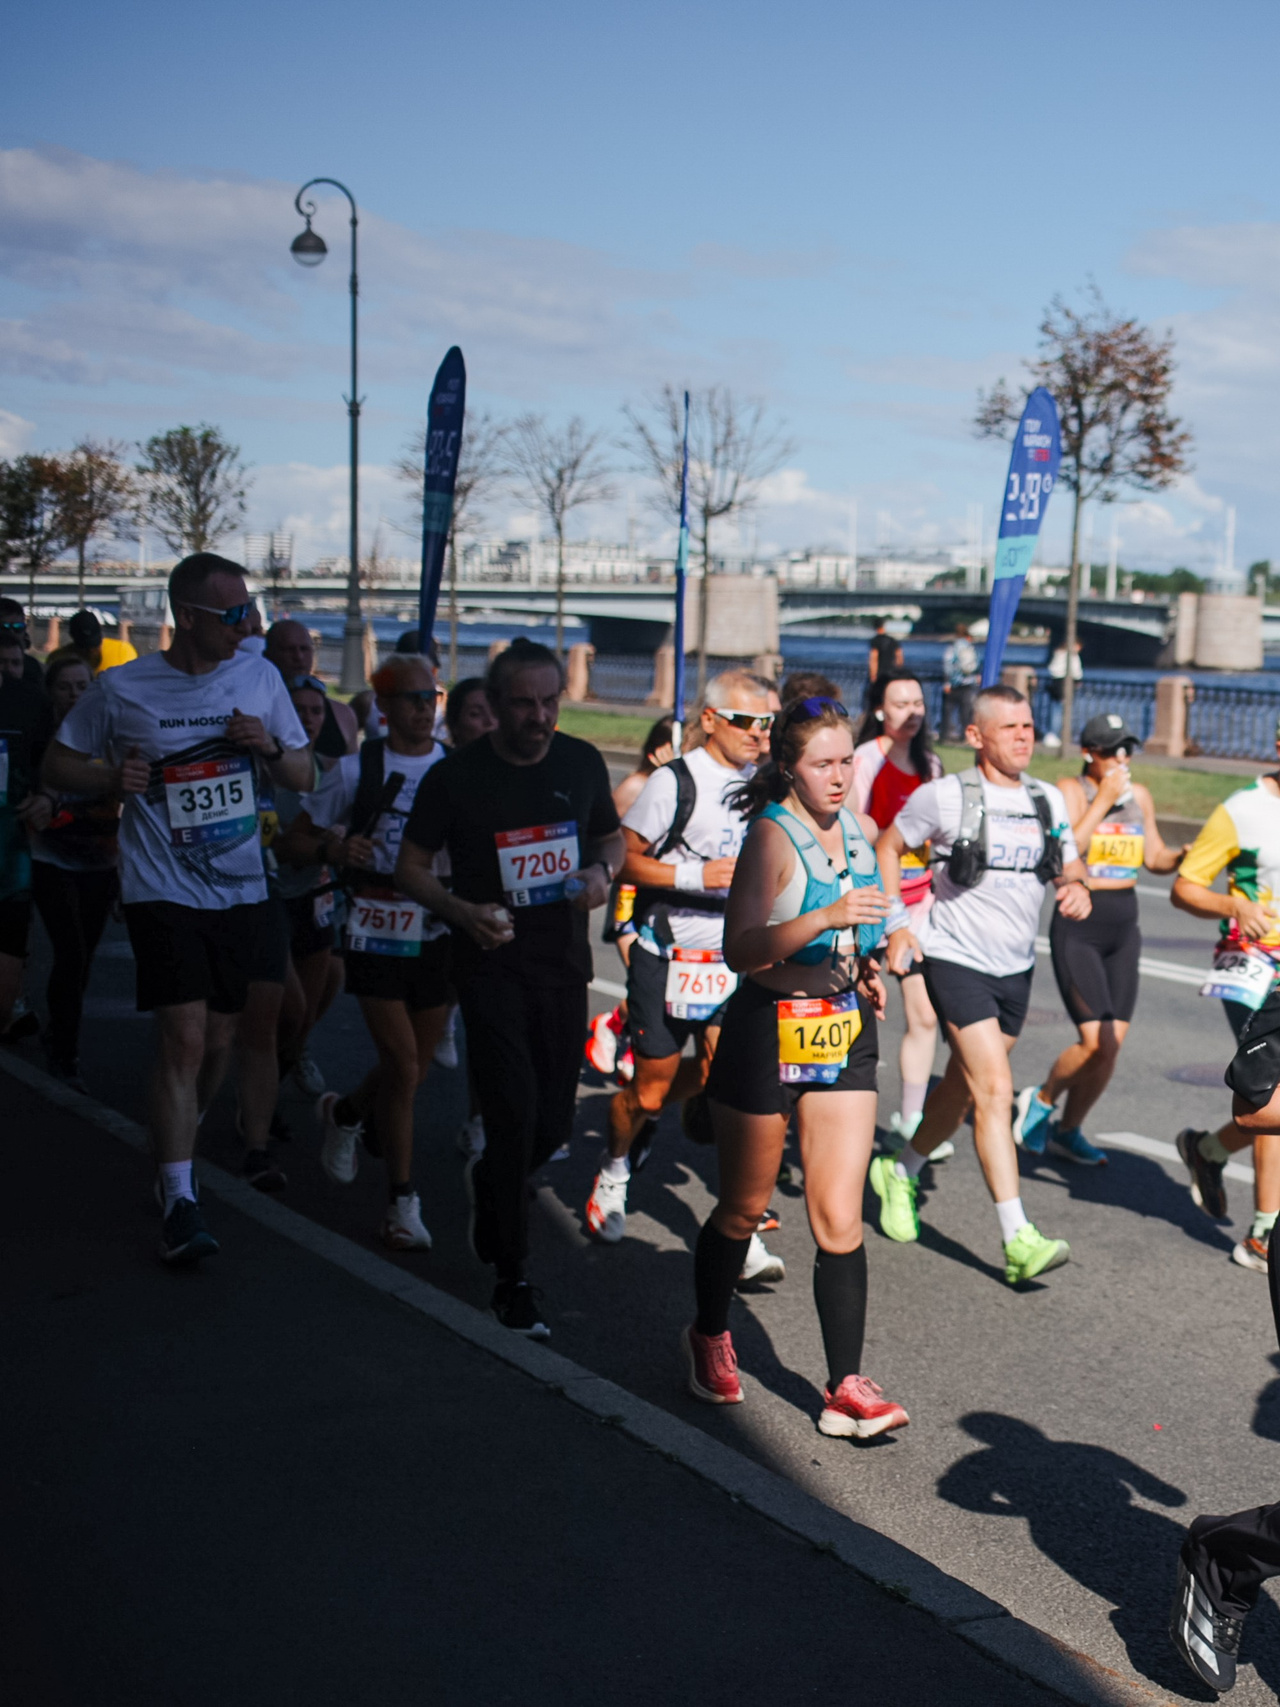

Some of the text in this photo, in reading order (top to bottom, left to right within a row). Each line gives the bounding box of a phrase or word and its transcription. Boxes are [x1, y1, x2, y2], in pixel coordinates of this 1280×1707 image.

[159, 714, 232, 729] RUN MOSCO
[179, 779, 244, 813] 3315
[201, 808, 230, 822] ДЕНИС
[181, 829, 193, 843] E
[1101, 840, 1136, 857] 1671
[511, 847, 571, 881] 7206
[358, 906, 415, 932] 7517
[677, 972, 729, 995] 7619
[794, 1019, 852, 1050] 1407
